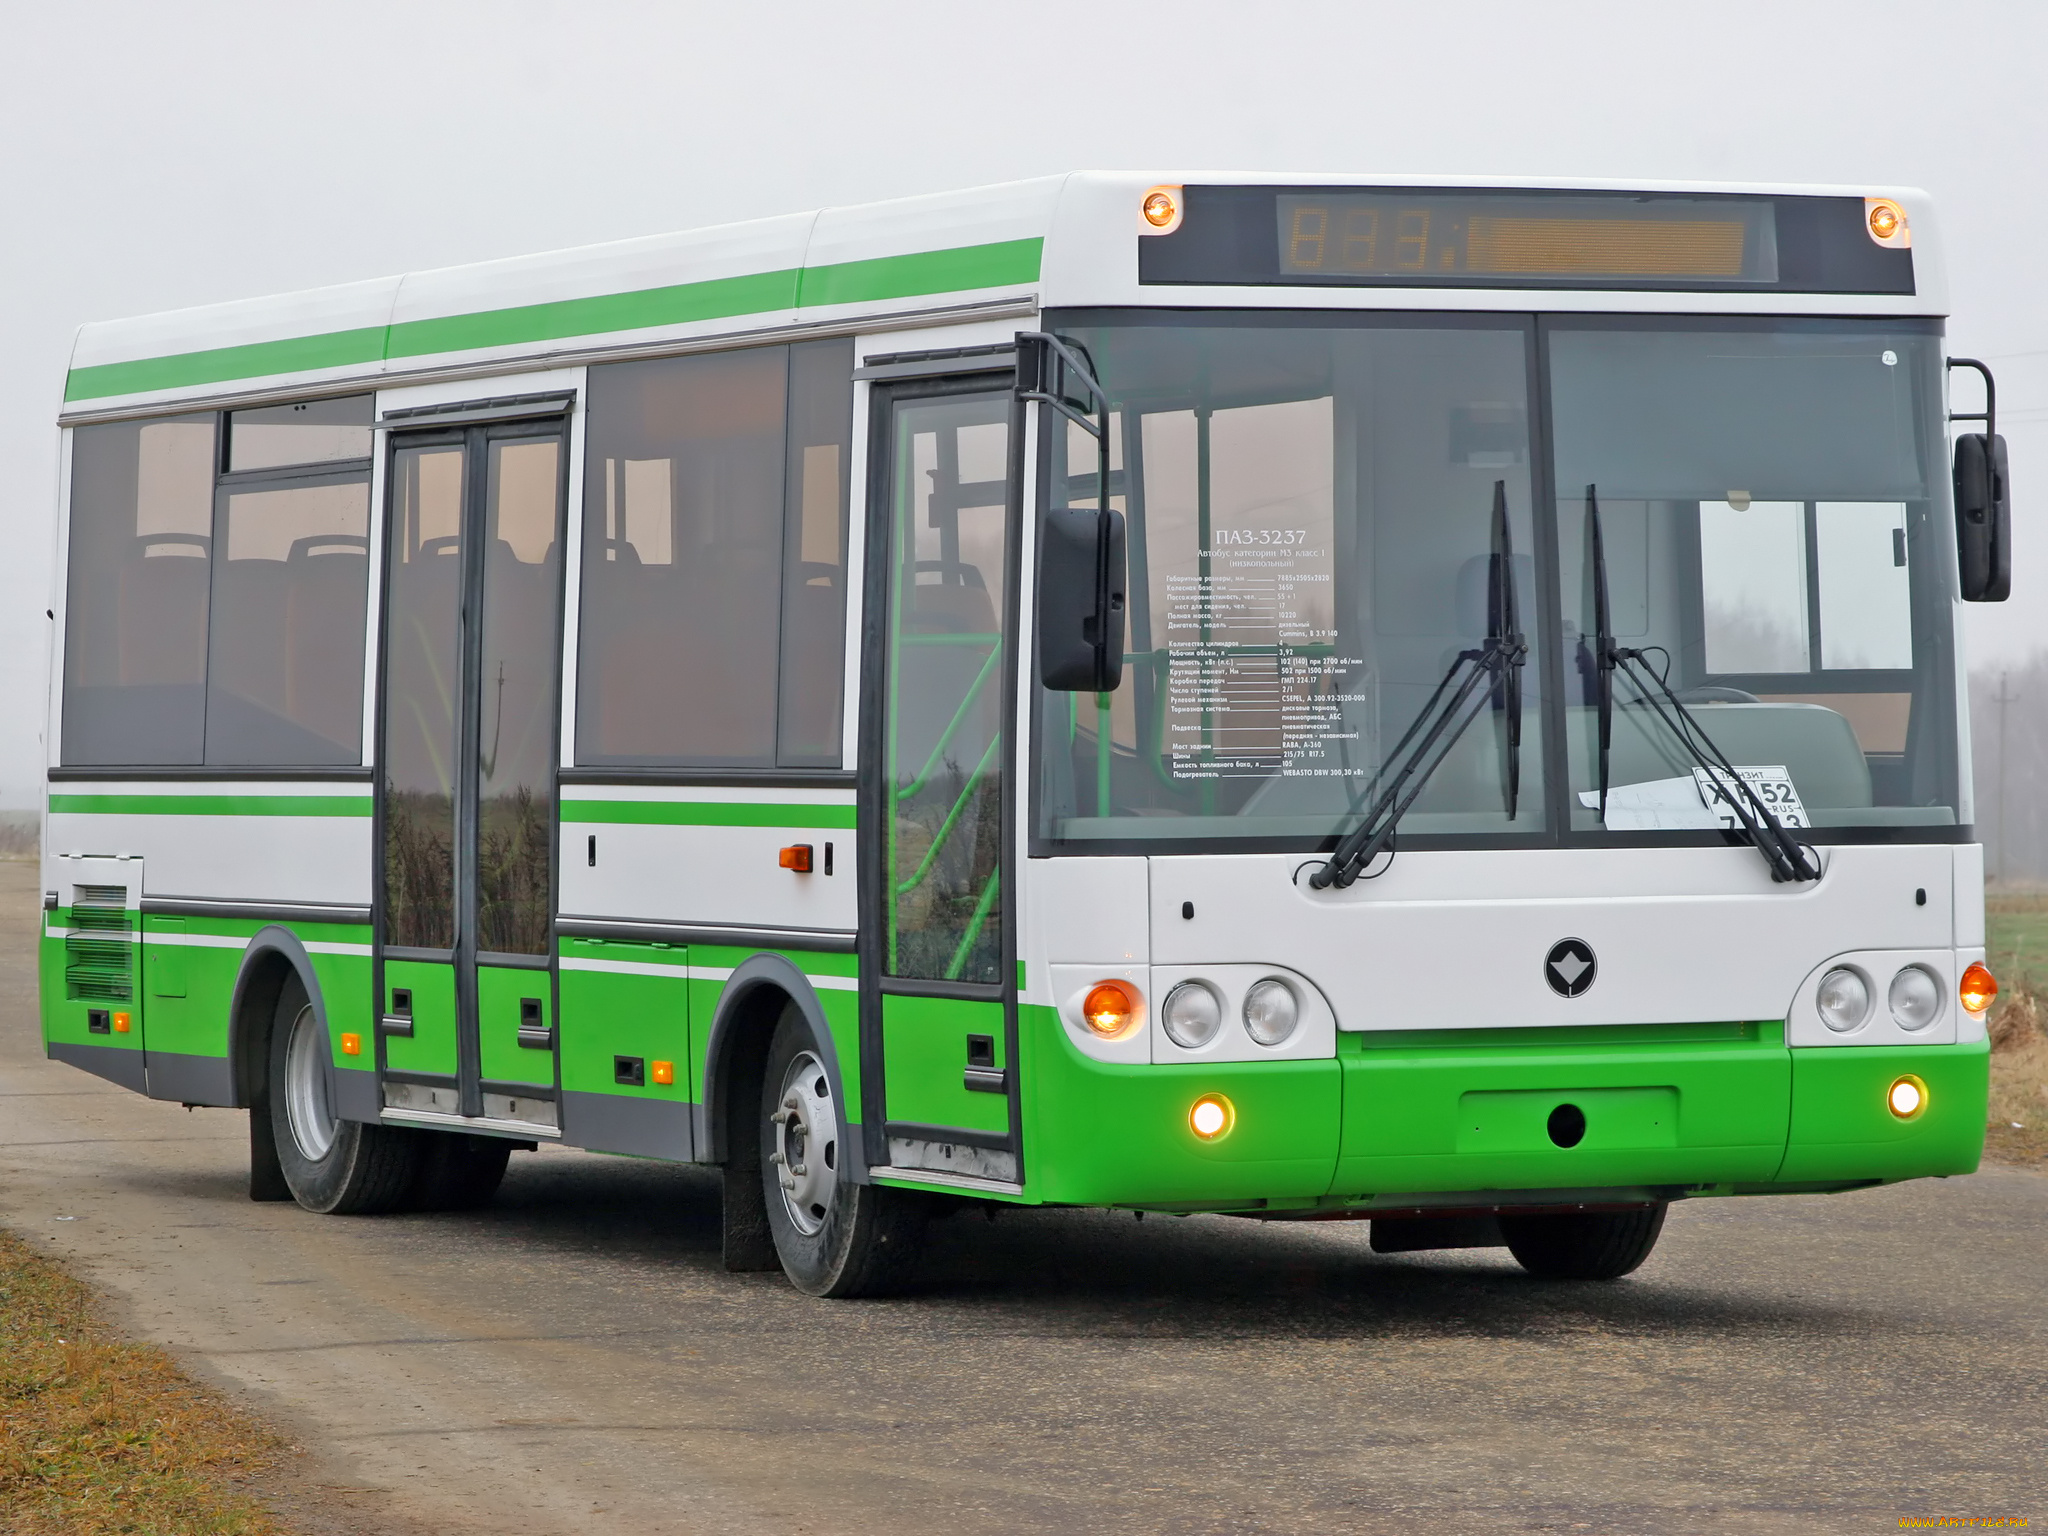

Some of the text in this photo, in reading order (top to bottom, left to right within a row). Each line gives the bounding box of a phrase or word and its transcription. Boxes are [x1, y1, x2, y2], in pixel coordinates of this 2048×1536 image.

[1216, 530, 1306, 545] ПАЗ-3237
[1279, 630, 1307, 638] Cummins,
[1279, 649, 1293, 657] 3,92
[1293, 658, 1308, 666] (140)
[1282, 695, 1304, 703] CSEPEL,
[1330, 769, 1352, 777] 300,30
[1720, 771, 1764, 780] ТРНЗИТ
[1760, 783, 1796, 803] 52
[1772, 805, 1794, 813] RUS
